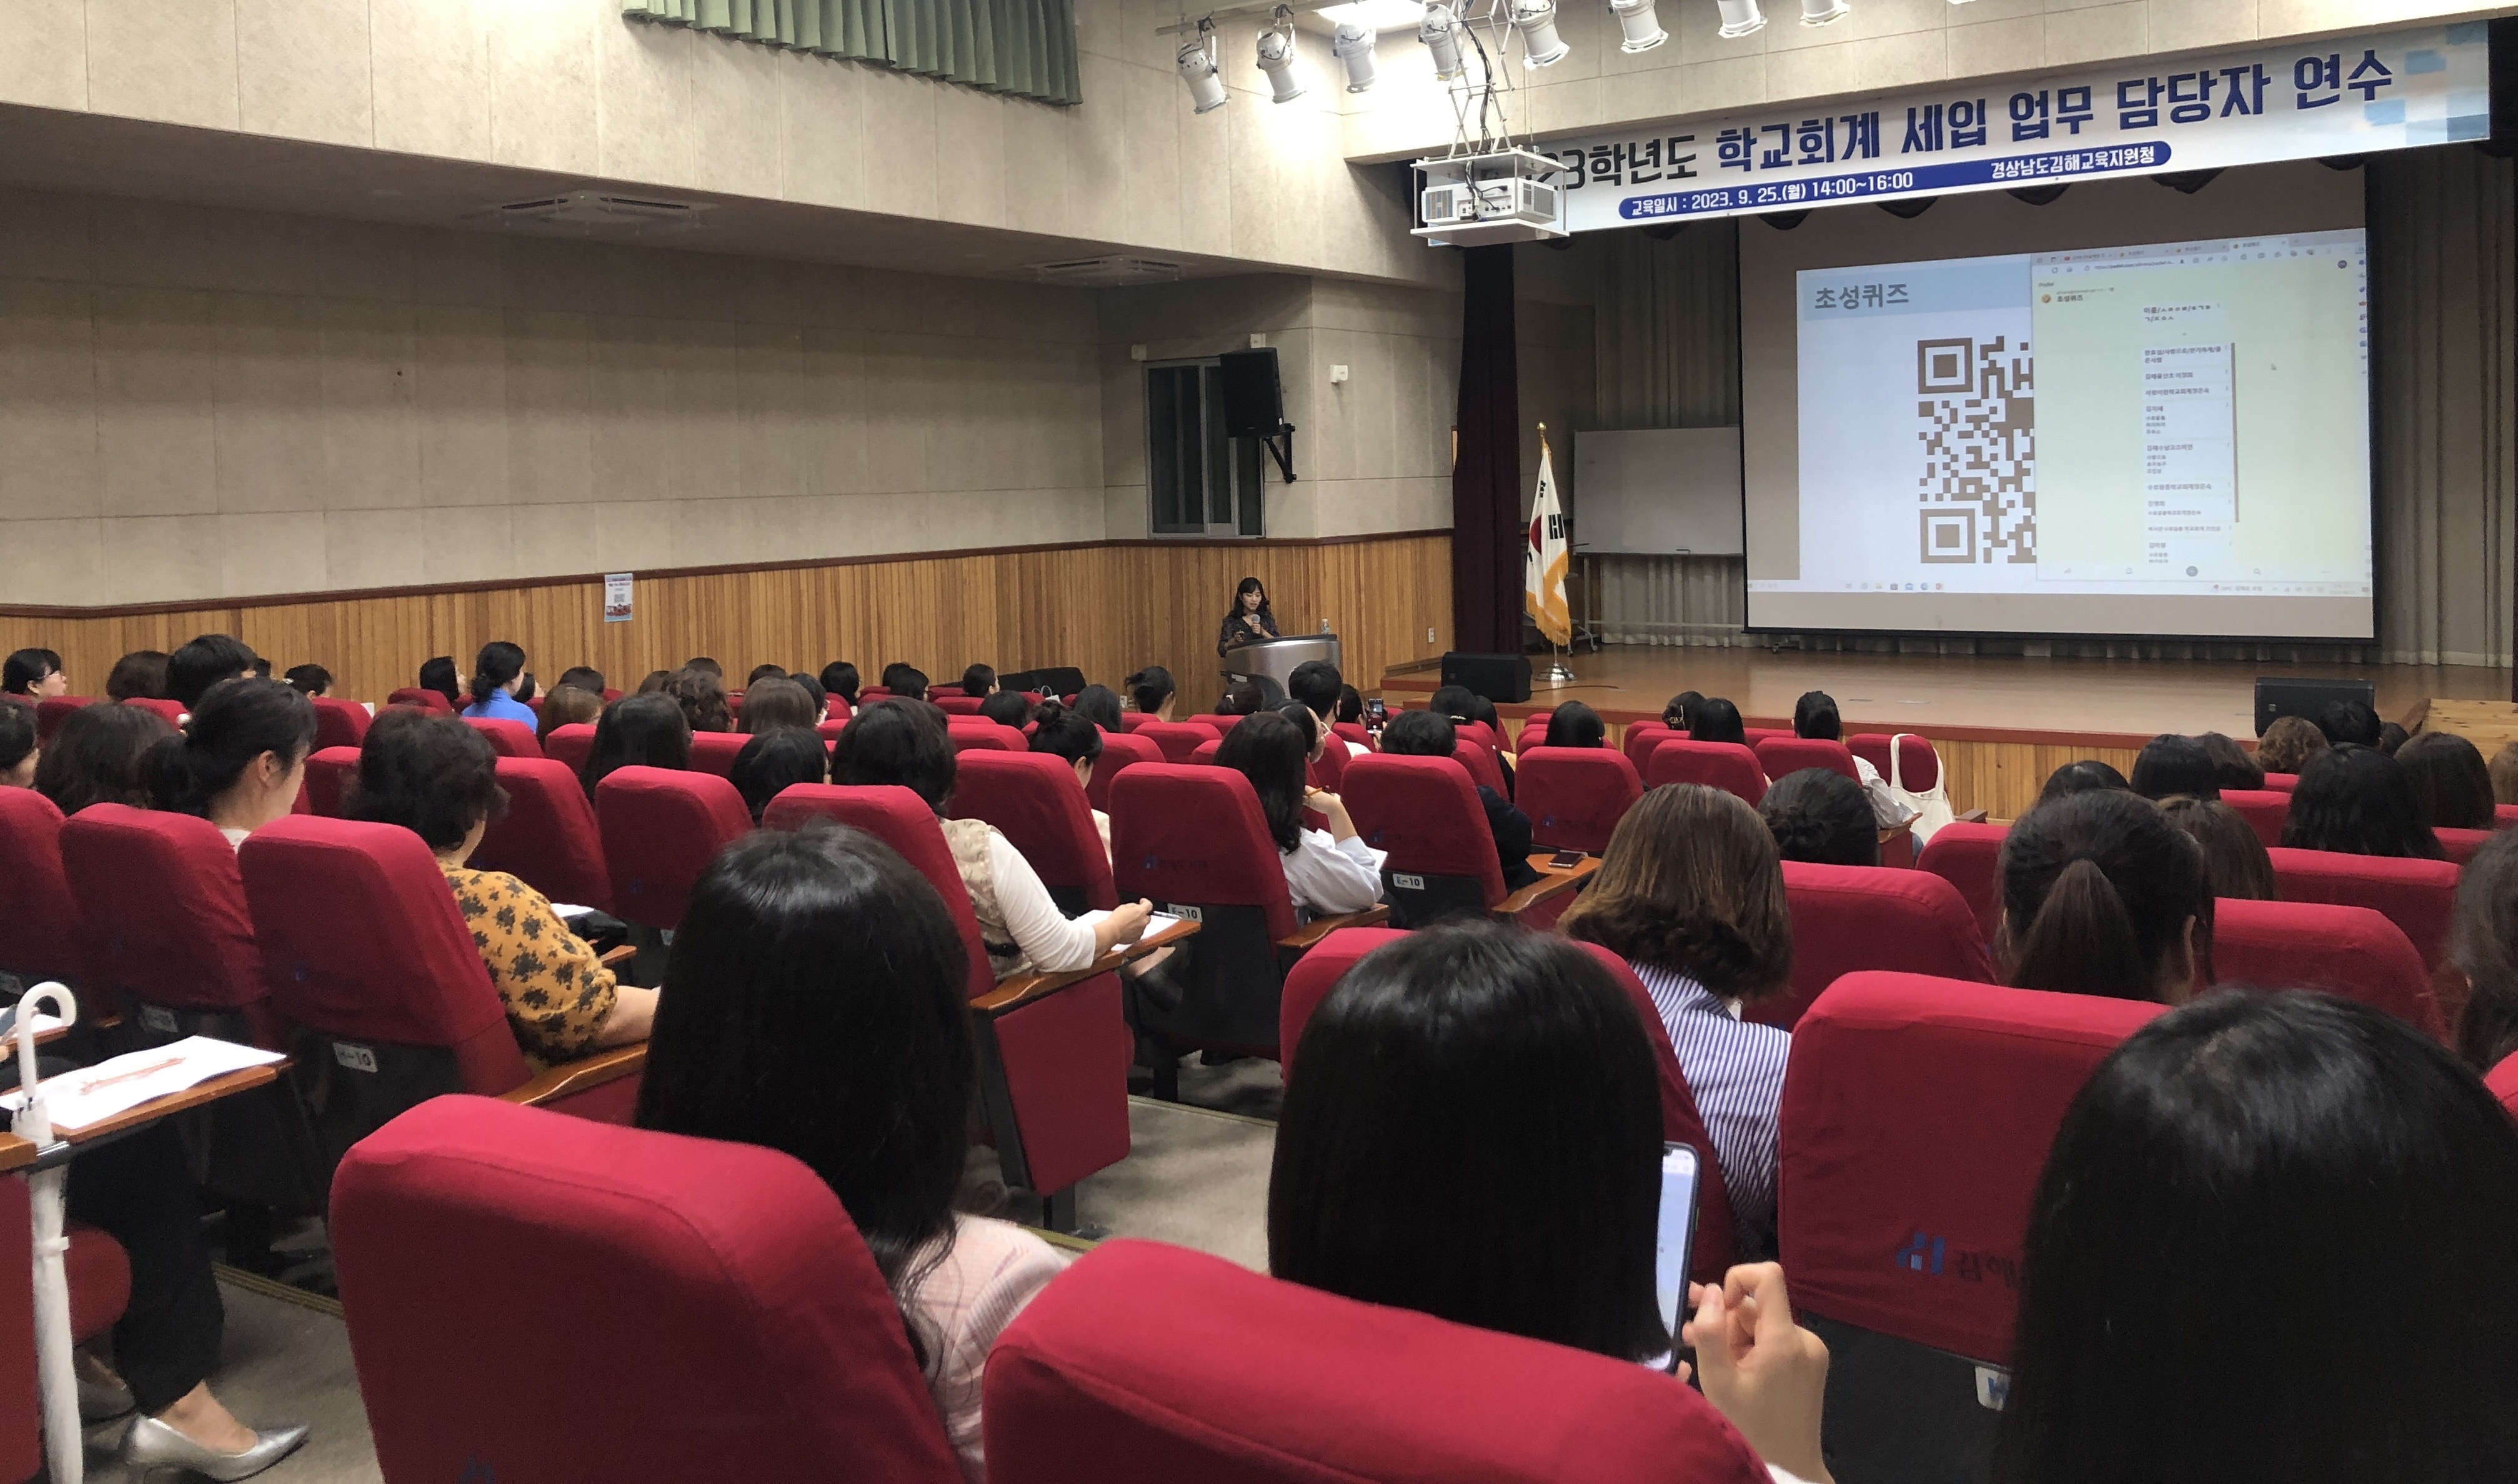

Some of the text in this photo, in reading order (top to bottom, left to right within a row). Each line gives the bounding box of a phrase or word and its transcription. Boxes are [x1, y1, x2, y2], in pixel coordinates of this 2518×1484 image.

[1716, 111, 1880, 172] 학교회계
[1901, 98, 1986, 154] 세입
[2008, 86, 2094, 142] 업무
[2116, 63, 2271, 130] 담당자
[2294, 49, 2392, 110] 연수
[1991, 146, 2155, 179] 경상남도김해교육지원청
[1631, 196, 1678, 216] 교육일시
[1691, 192, 1733, 209] 2023.
[1738, 190, 1752, 205] 9.
[1812, 172, 1914, 196] 14:00~16:00
[1814, 283, 1909, 310] 초성퀴즈
